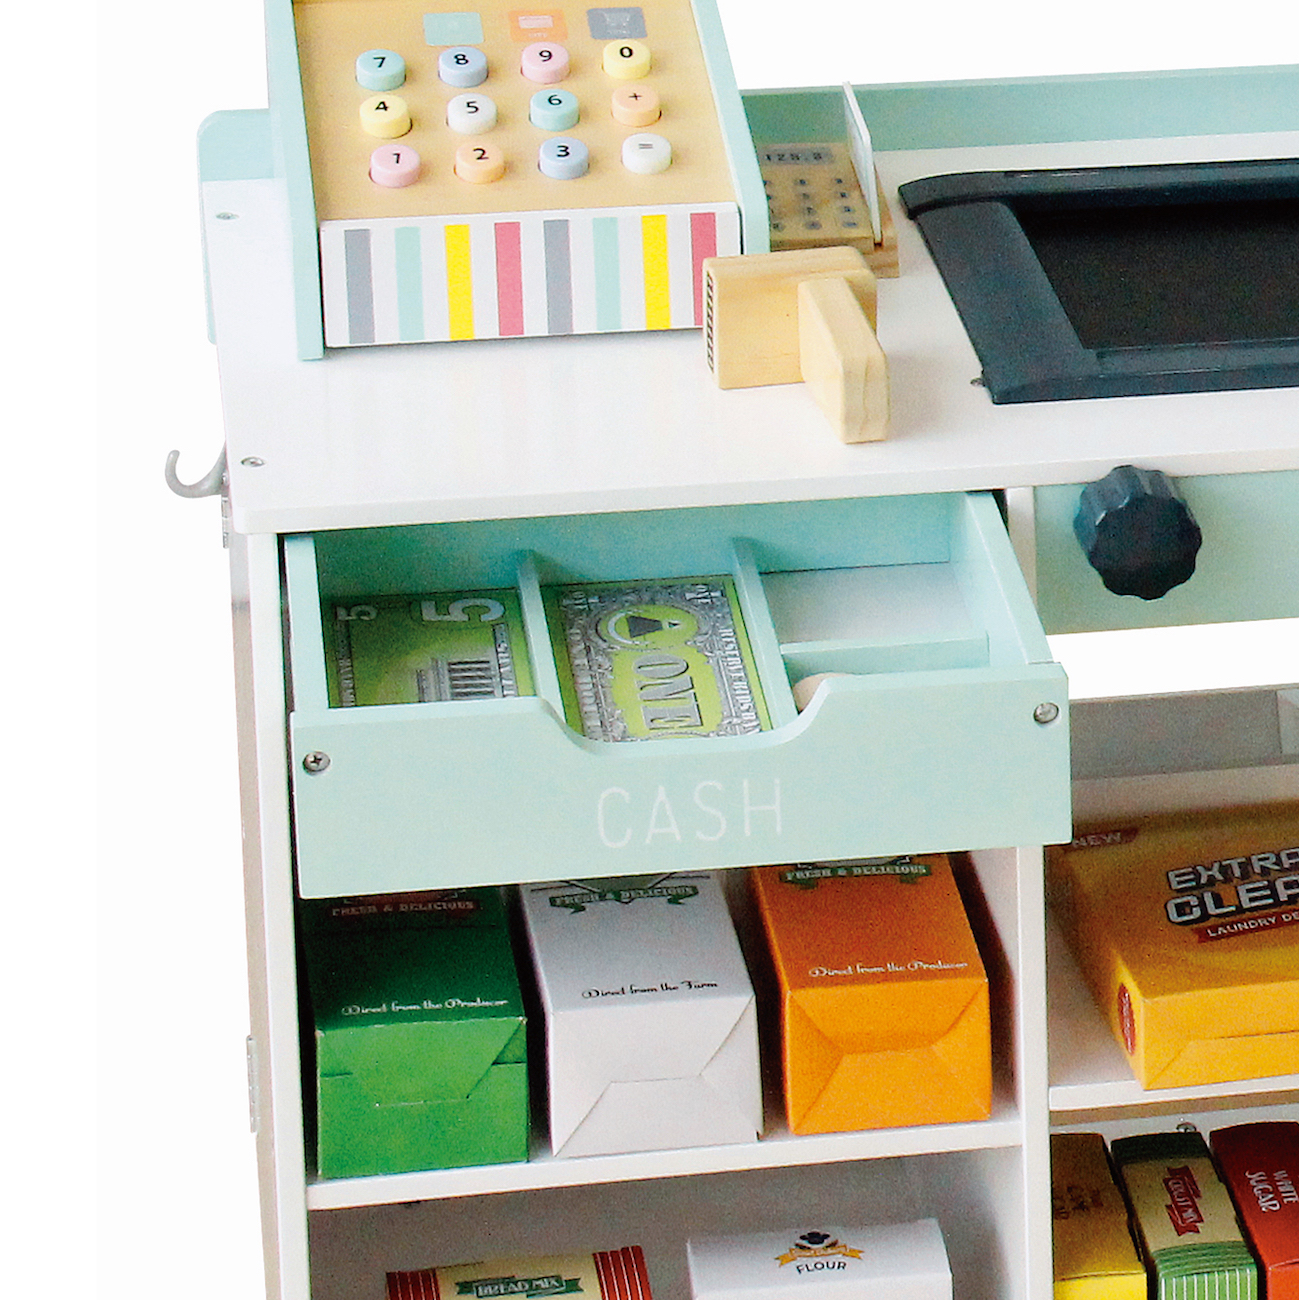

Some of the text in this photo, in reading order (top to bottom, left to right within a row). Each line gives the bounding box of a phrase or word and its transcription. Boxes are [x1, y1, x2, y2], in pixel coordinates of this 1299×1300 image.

[373, 46, 634, 69] 7 8 9 0
[375, 101, 389, 113] 4
[466, 101, 480, 114] 5
[548, 94, 563, 107] 6
[393, 152, 402, 165] 1
[473, 147, 489, 161] 2
[556, 144, 570, 158] 3
[336, 604, 378, 621] 5
[420, 597, 506, 623] 5
[634, 652, 703, 731] ONE
[598, 776, 782, 850] CASH
[1071, 832, 1122, 848] NEW
[786, 865, 926, 881] FRESH & DELICIOUS
[620, 887, 692, 900] DELICIOUS
[399, 901, 474, 913] DELICIOUS
[1207, 916, 1278, 937] LAUNDRY
[856, 963, 886, 973] from
[886, 962, 906, 971] the
[630, 983, 658, 994] from
[660, 982, 678, 991] the
[391, 1001, 421, 1011] from
[423, 999, 442, 1010] the
[1245, 1170, 1281, 1213] SUGAR
[796, 1261, 847, 1275] FLOUR
[478, 1277, 560, 1296] BREAD MIX
